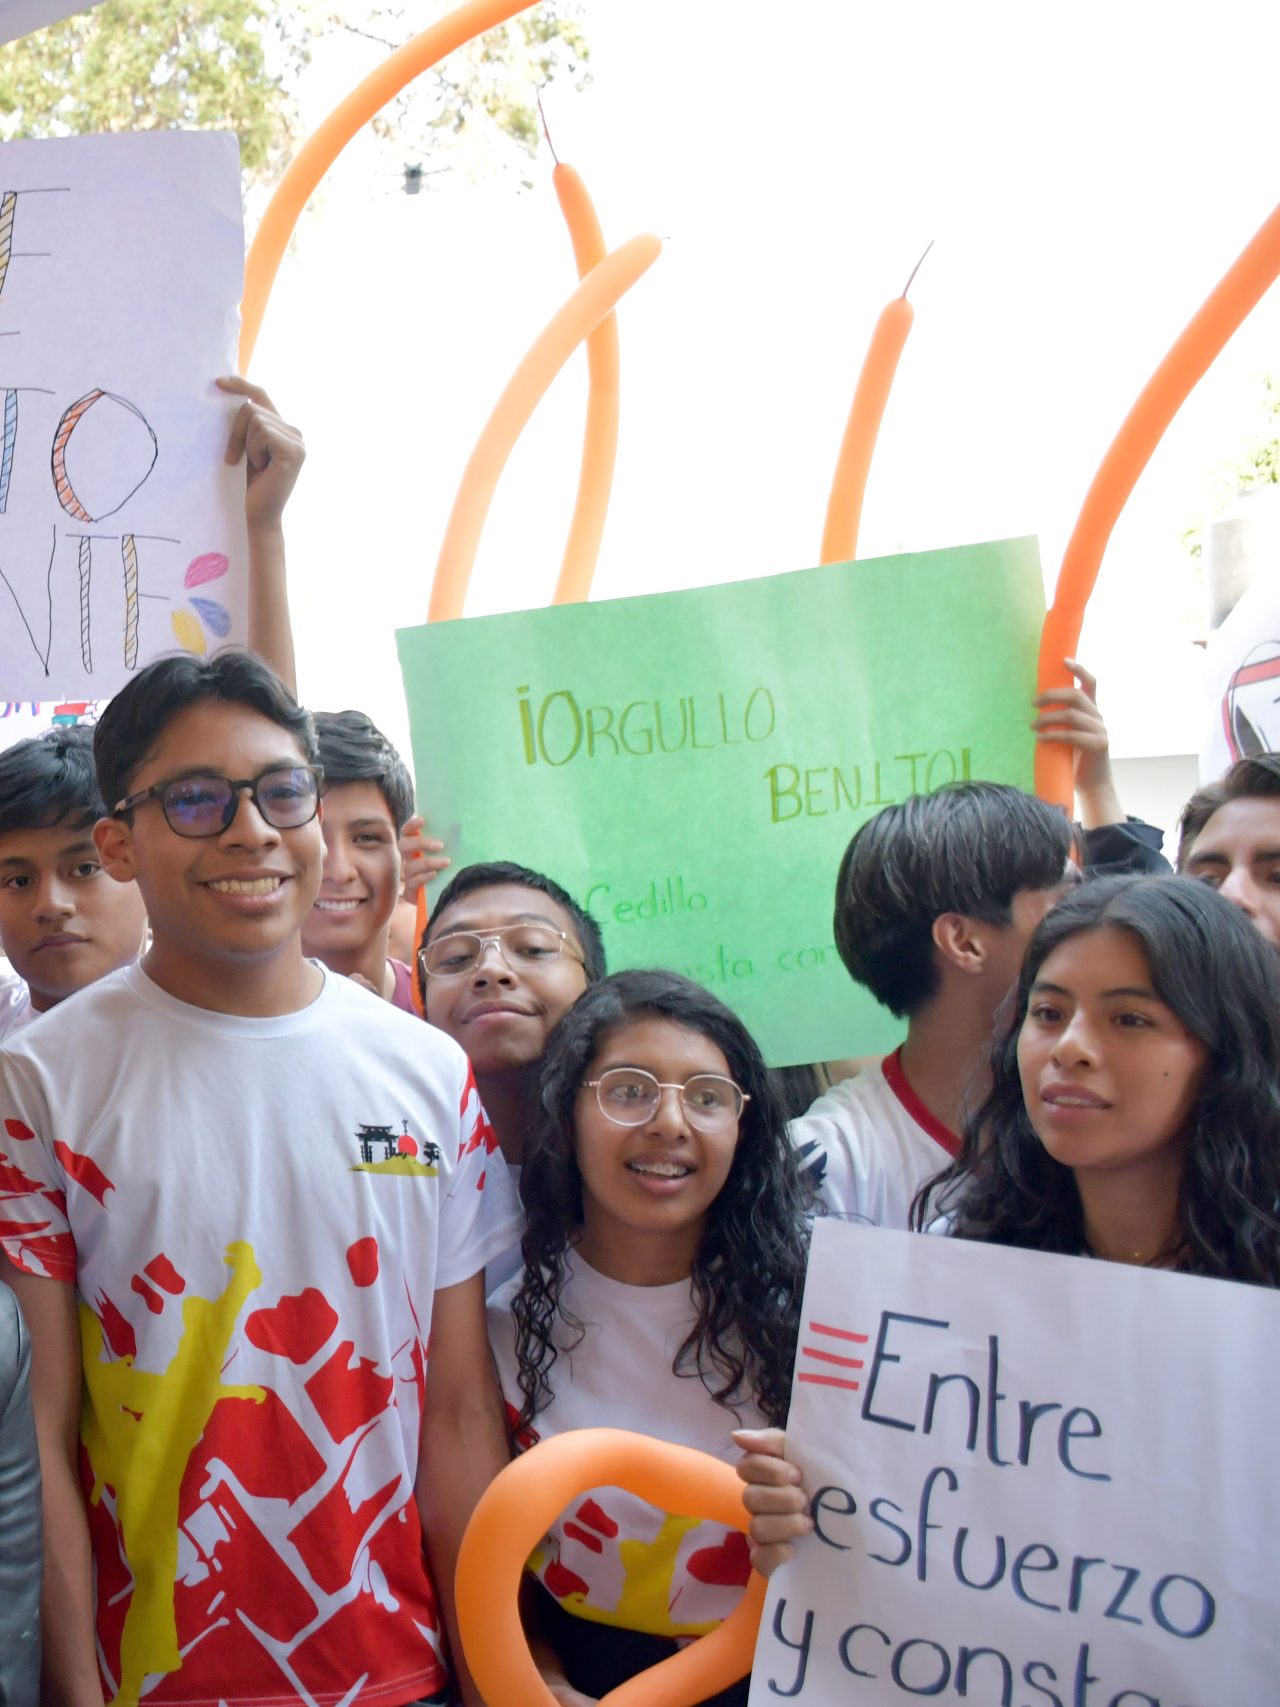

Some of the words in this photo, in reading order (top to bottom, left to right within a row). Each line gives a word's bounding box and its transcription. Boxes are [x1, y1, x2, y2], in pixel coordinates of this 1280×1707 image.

[584, 876, 708, 925] Cedillo
[862, 1311, 1112, 1482] Entre
[810, 1466, 1216, 1639] esfuerzo
[768, 1598, 814, 1698] y
[838, 1624, 1162, 1707] const
